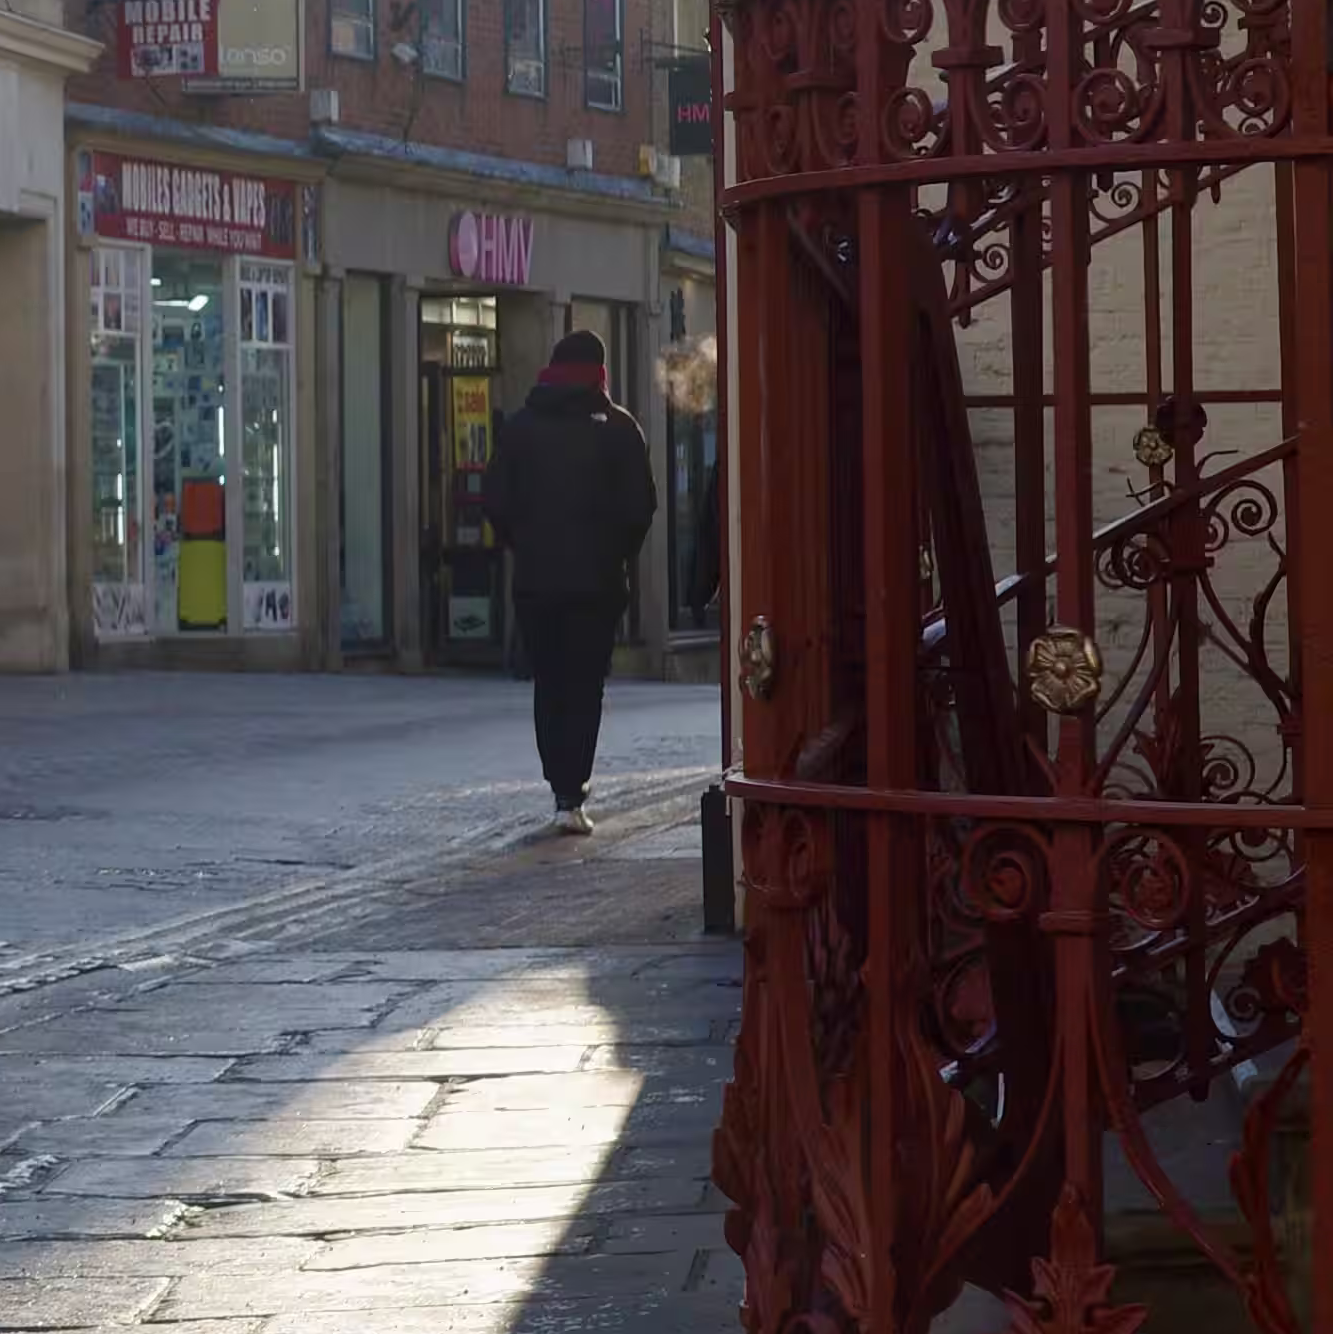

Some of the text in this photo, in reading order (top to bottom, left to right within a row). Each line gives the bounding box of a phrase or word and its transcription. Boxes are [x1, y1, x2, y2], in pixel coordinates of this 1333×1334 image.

[132, 22, 203, 44] REPAIR
[121, 161, 171, 215] MOBILES
[172, 166, 221, 220] GADGETS
[232, 176, 267, 230] VAPES
